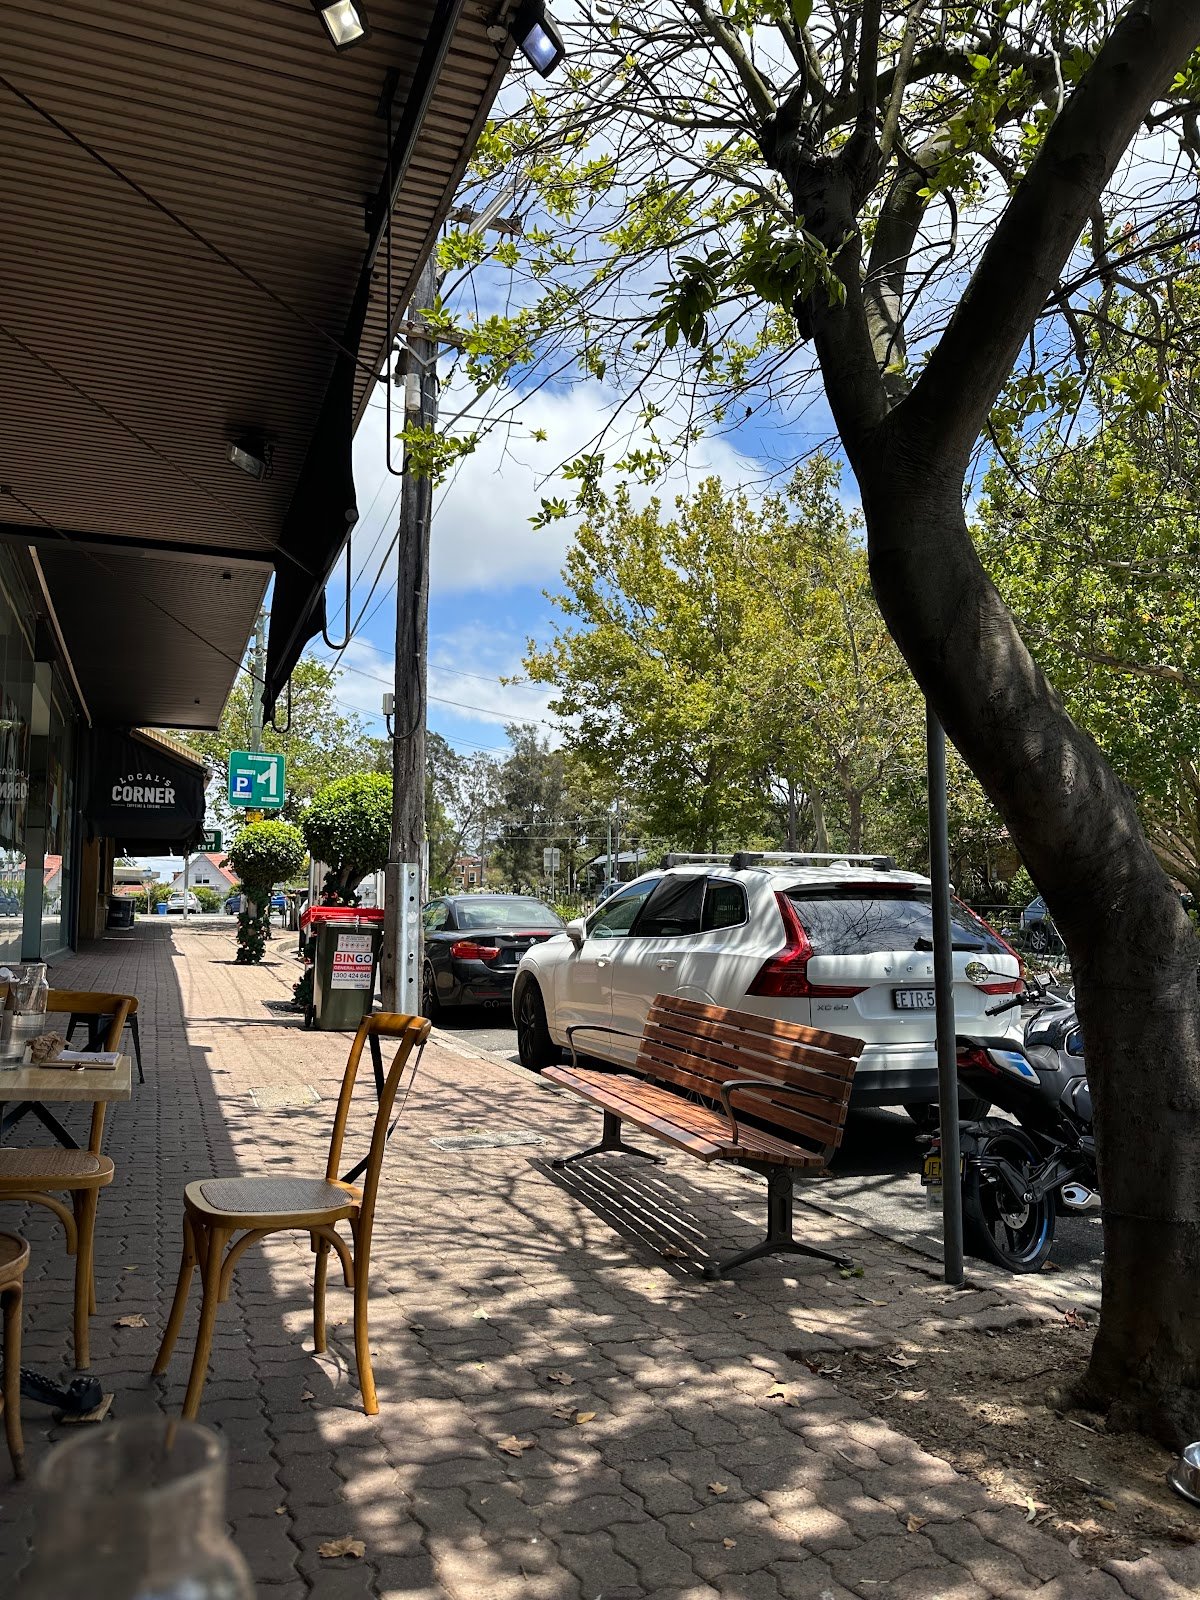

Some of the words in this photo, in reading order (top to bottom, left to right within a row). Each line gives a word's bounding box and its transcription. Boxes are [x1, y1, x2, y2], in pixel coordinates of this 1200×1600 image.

[119, 772, 172, 787] LOCAL'S
[236, 776, 249, 792] P
[112, 785, 176, 804] CORNER
[335, 953, 372, 964] BINGO
[883, 966, 934, 976] VOL
[900, 991, 936, 1007] EIR·5
